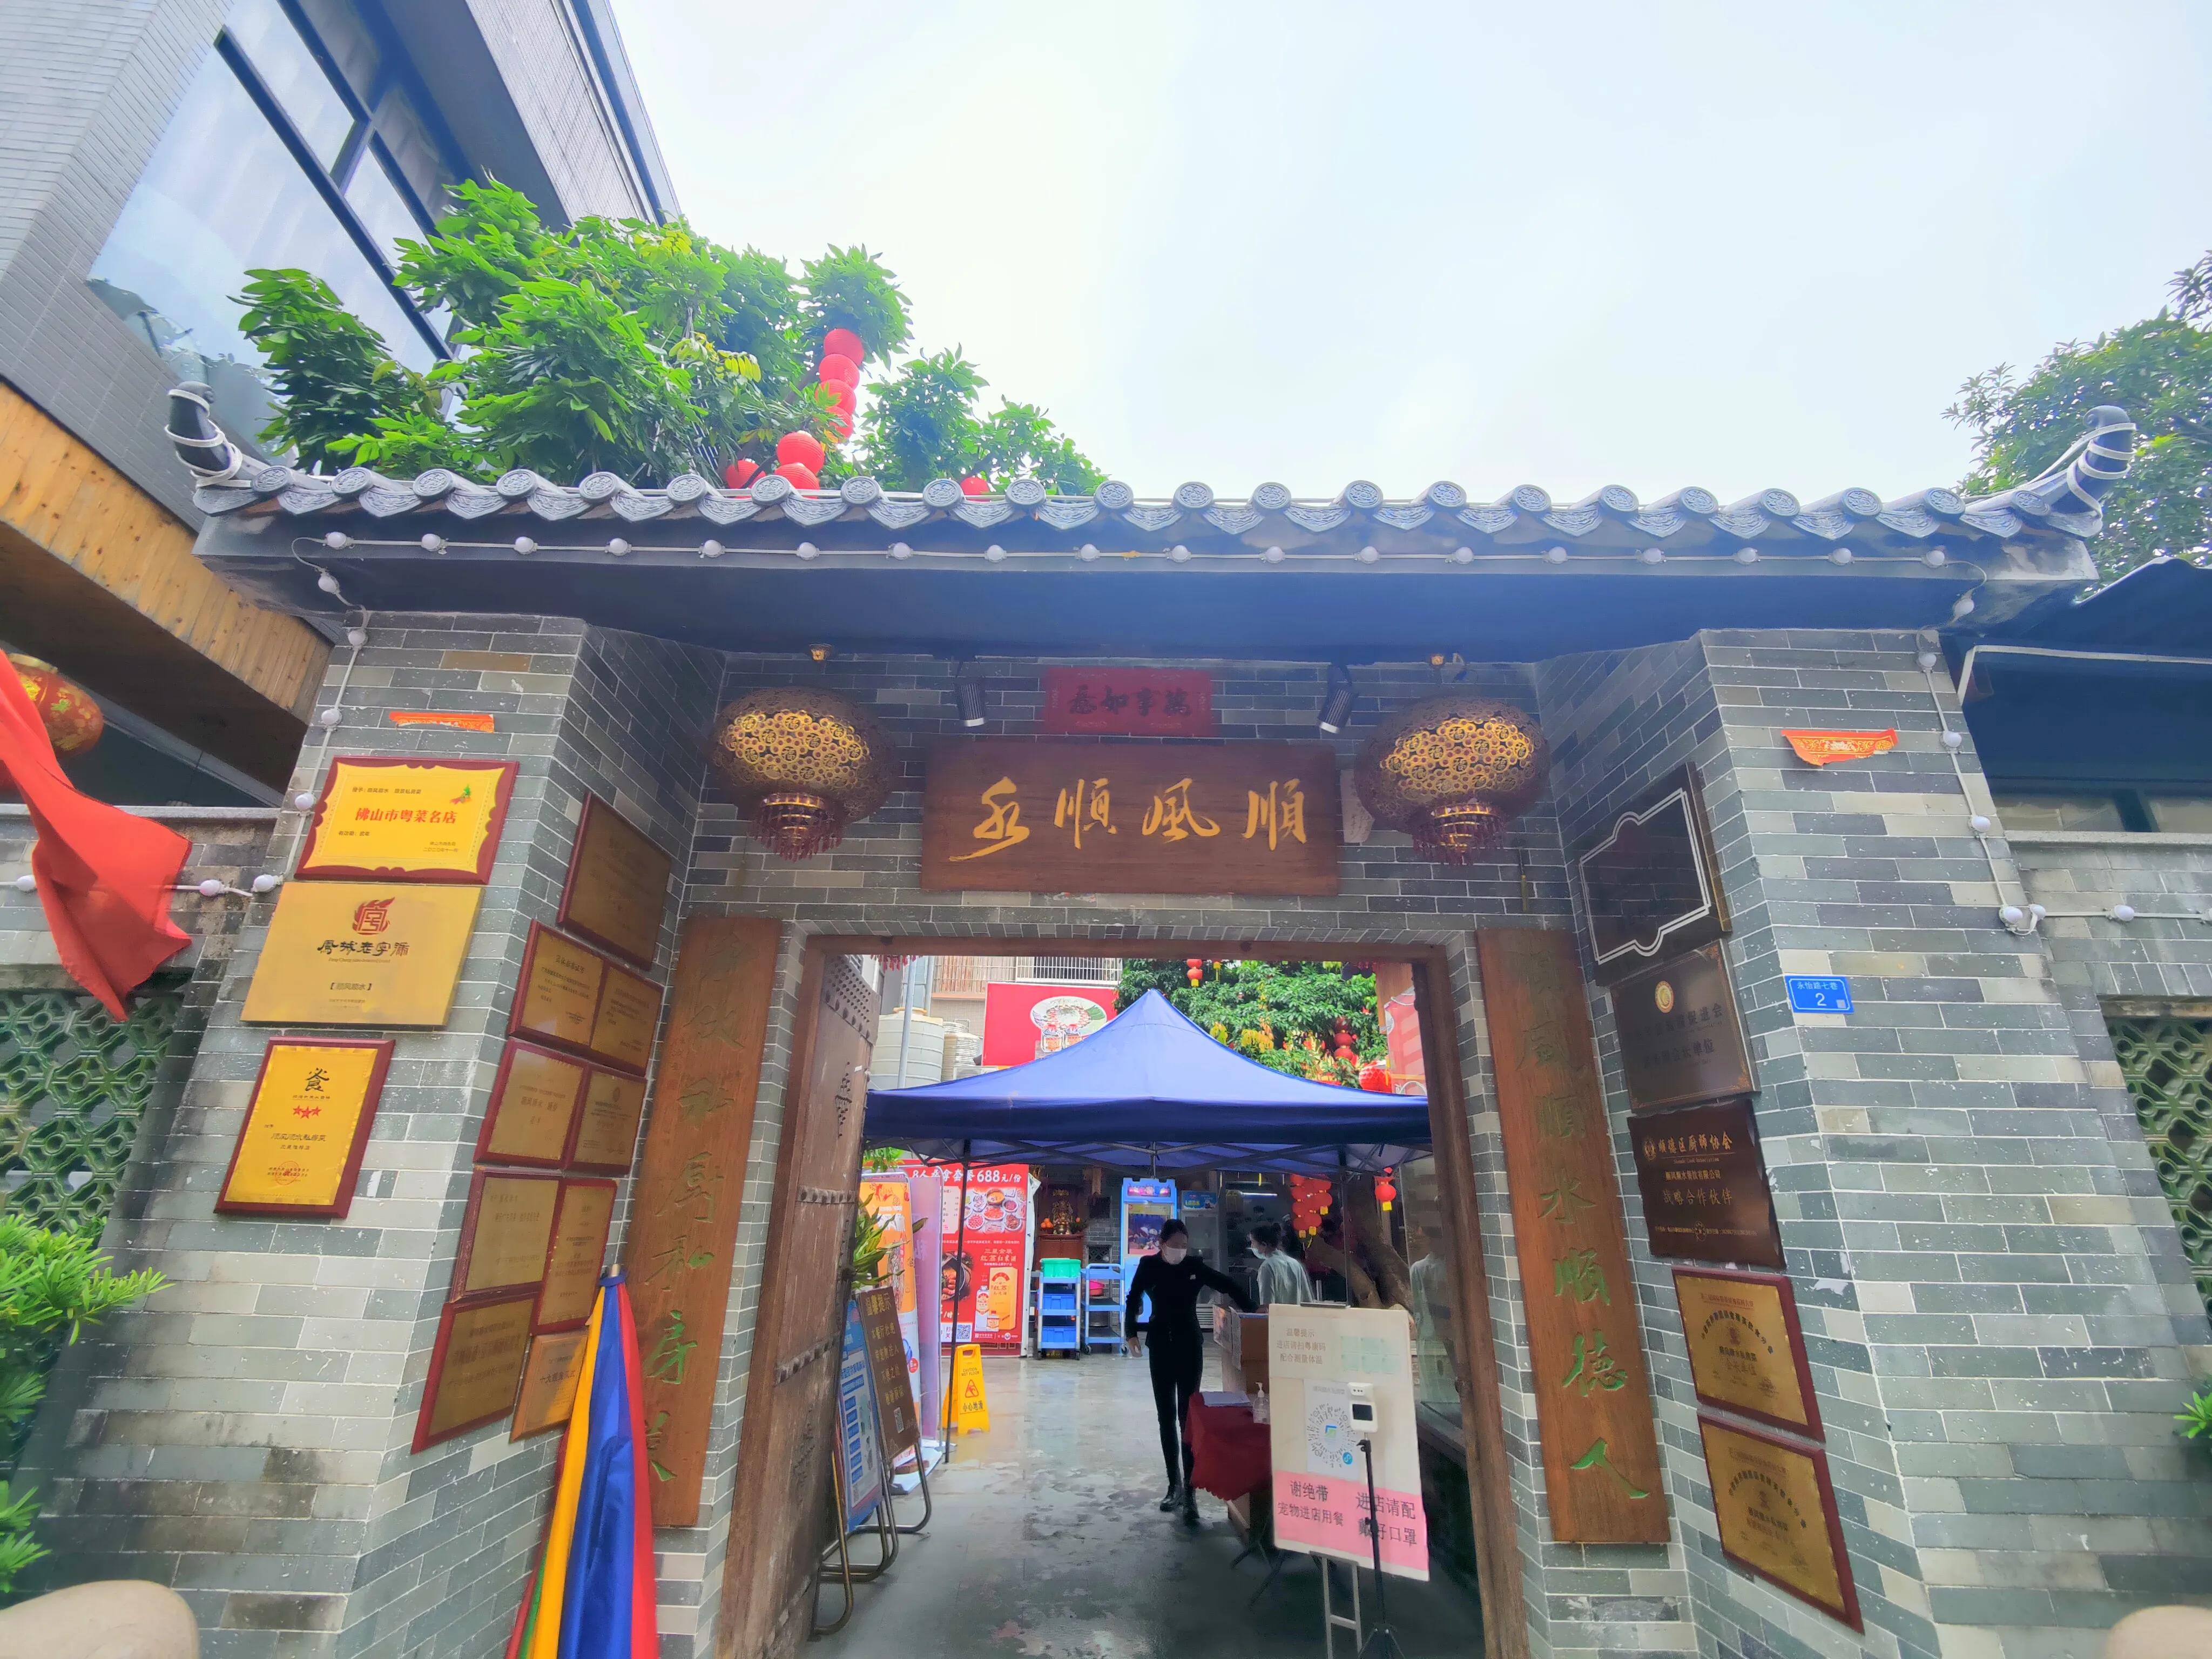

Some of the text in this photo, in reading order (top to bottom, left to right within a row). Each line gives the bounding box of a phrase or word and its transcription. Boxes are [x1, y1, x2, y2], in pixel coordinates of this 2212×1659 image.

[355, 808, 457, 824] 佛山市粤菜名店
[1815, 993, 1827, 1006] 2
[1286, 1328, 1315, 1338] 温馨提示
[1276, 1339, 1326, 1352] 进店请扫粤康码
[1280, 1353, 1323, 1365] 配合测量体温
[962, 1400, 983, 1412] 小心地滑
[1290, 1480, 1329, 1502] 谢绝带
[1277, 1501, 1344, 1527] 宠物进店用餐
